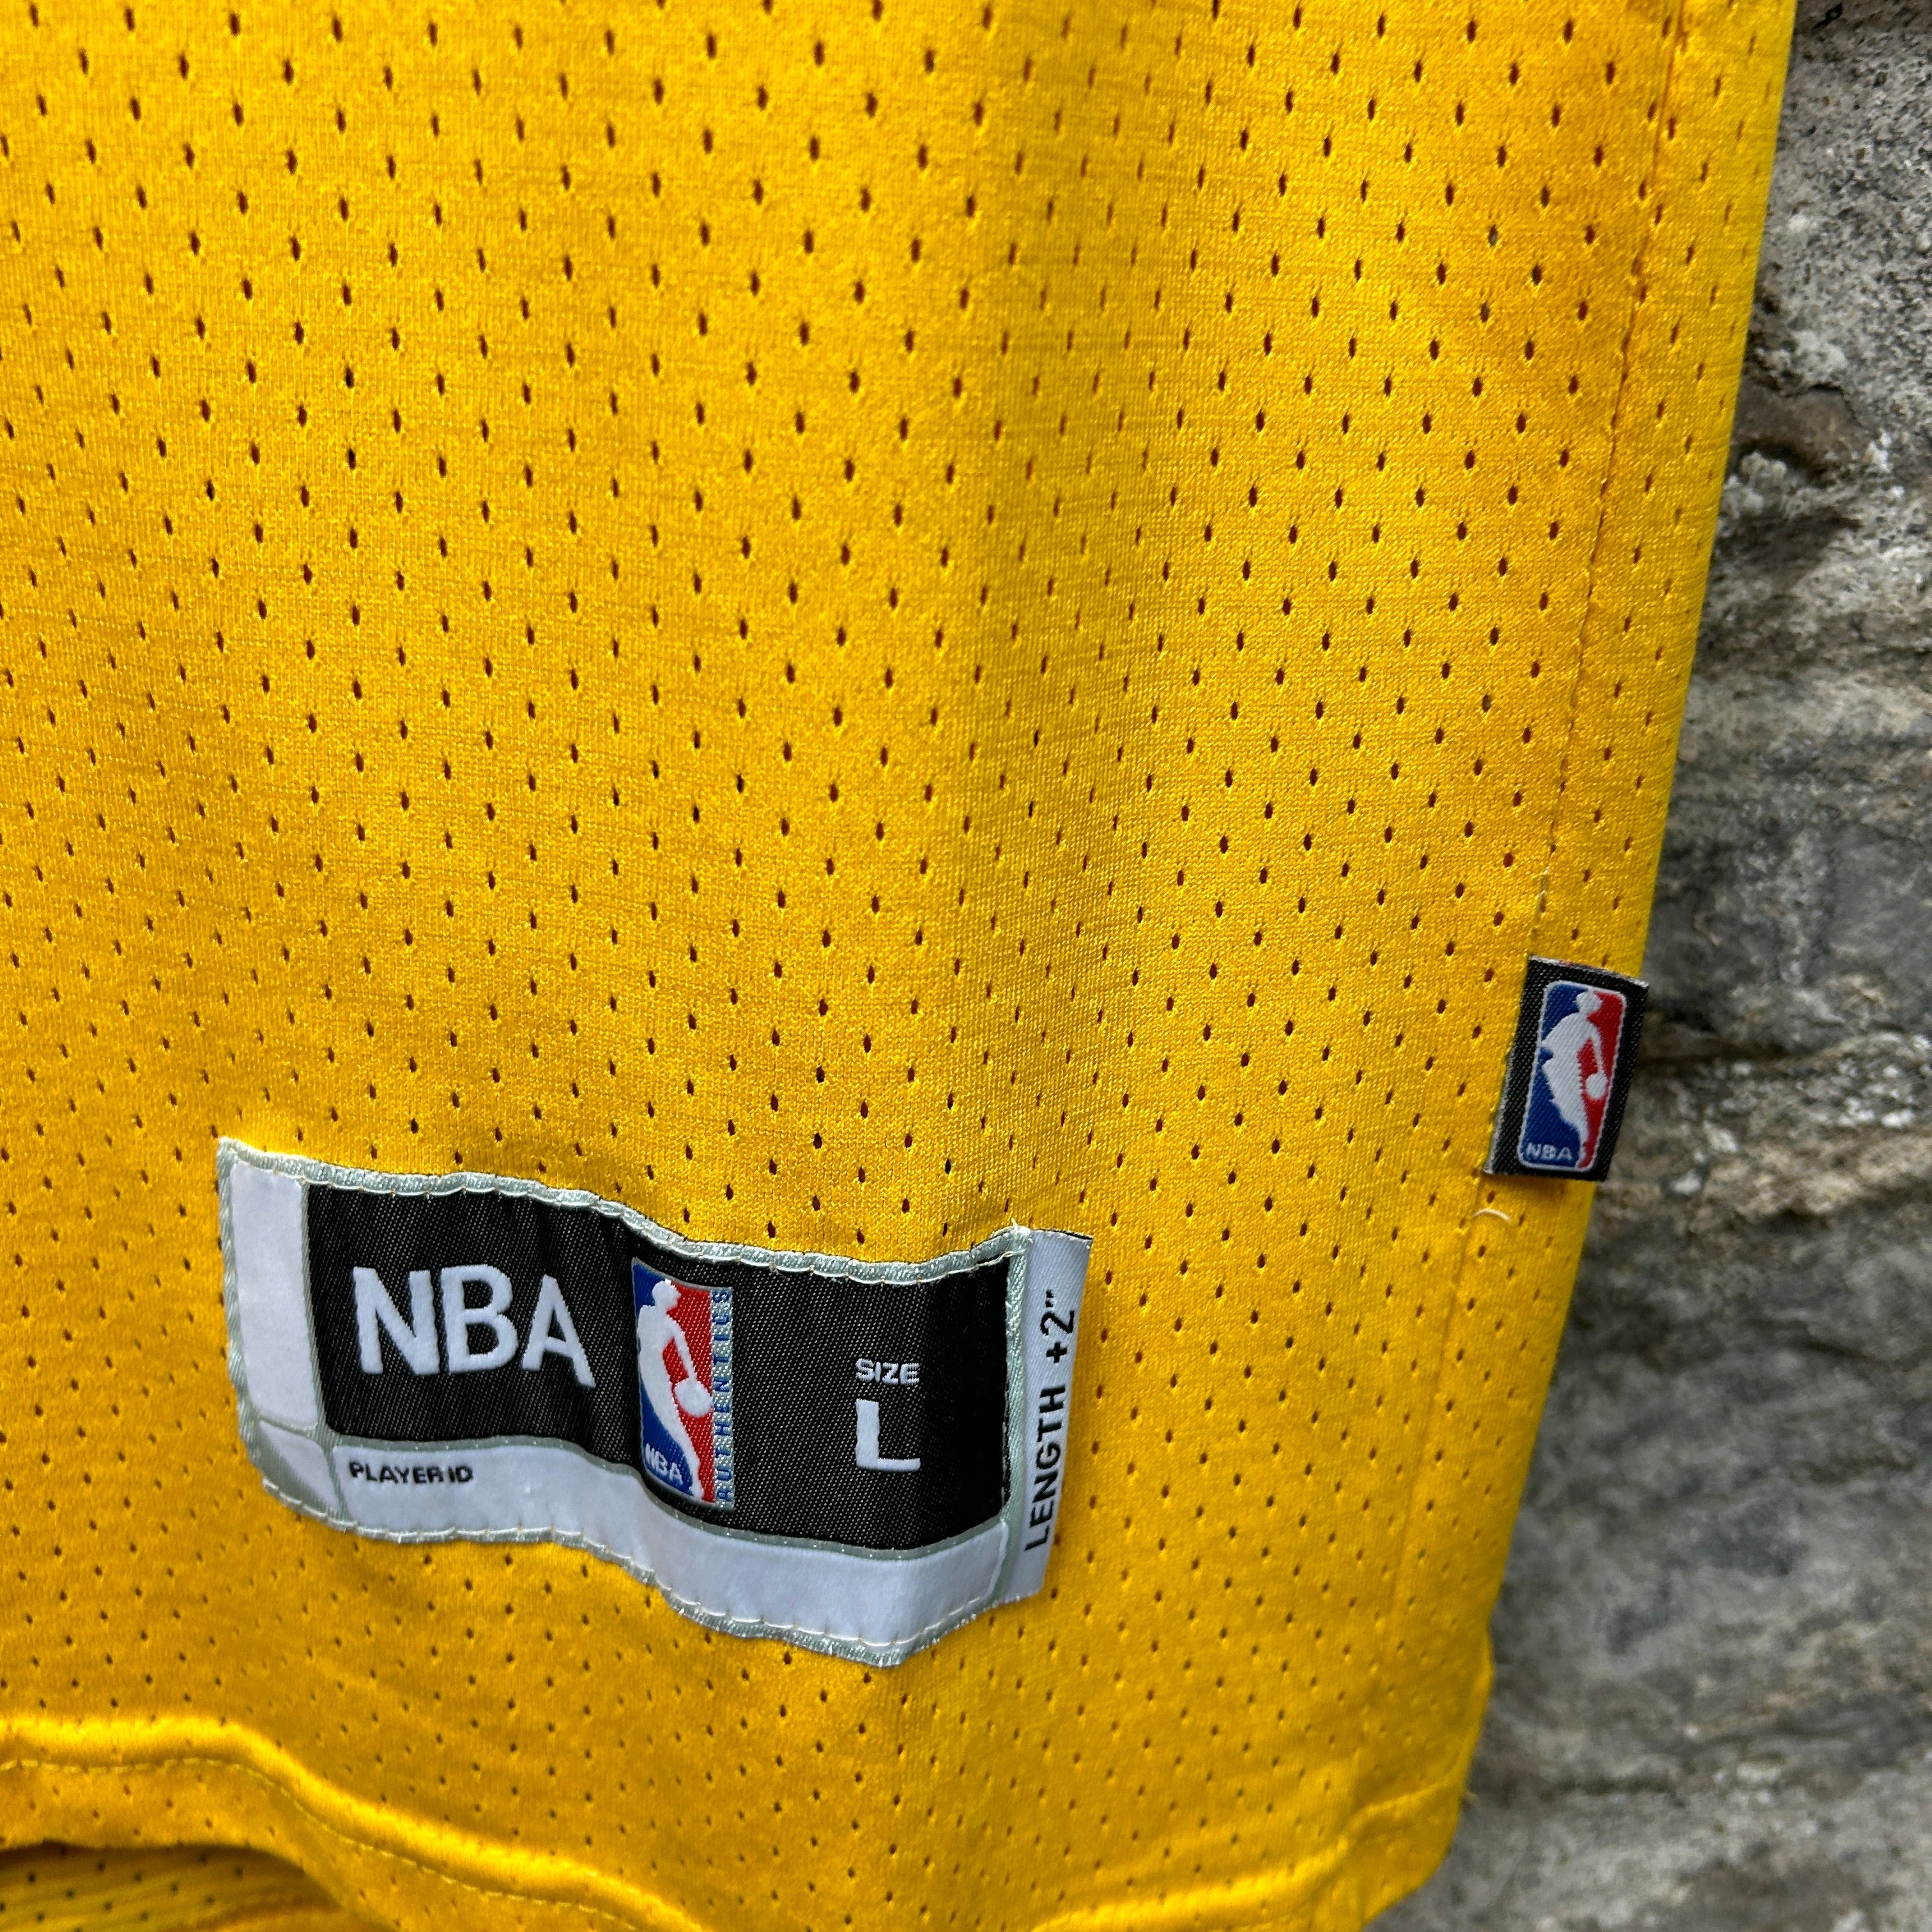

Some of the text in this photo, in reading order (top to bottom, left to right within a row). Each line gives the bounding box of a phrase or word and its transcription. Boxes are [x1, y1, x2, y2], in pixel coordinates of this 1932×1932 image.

[1526, 1142, 1573, 1162] NBA
[353, 1264, 596, 1389] NBA
[713, 1290, 733, 1503] AUTHENTICS
[855, 1358, 921, 1386] SIZE
[645, 1442, 684, 1485] NBA
[855, 1398, 921, 1471] L
[348, 1460, 473, 1484] PLAYER ID
[1024, 1384, 1067, 1551] LENGTH
